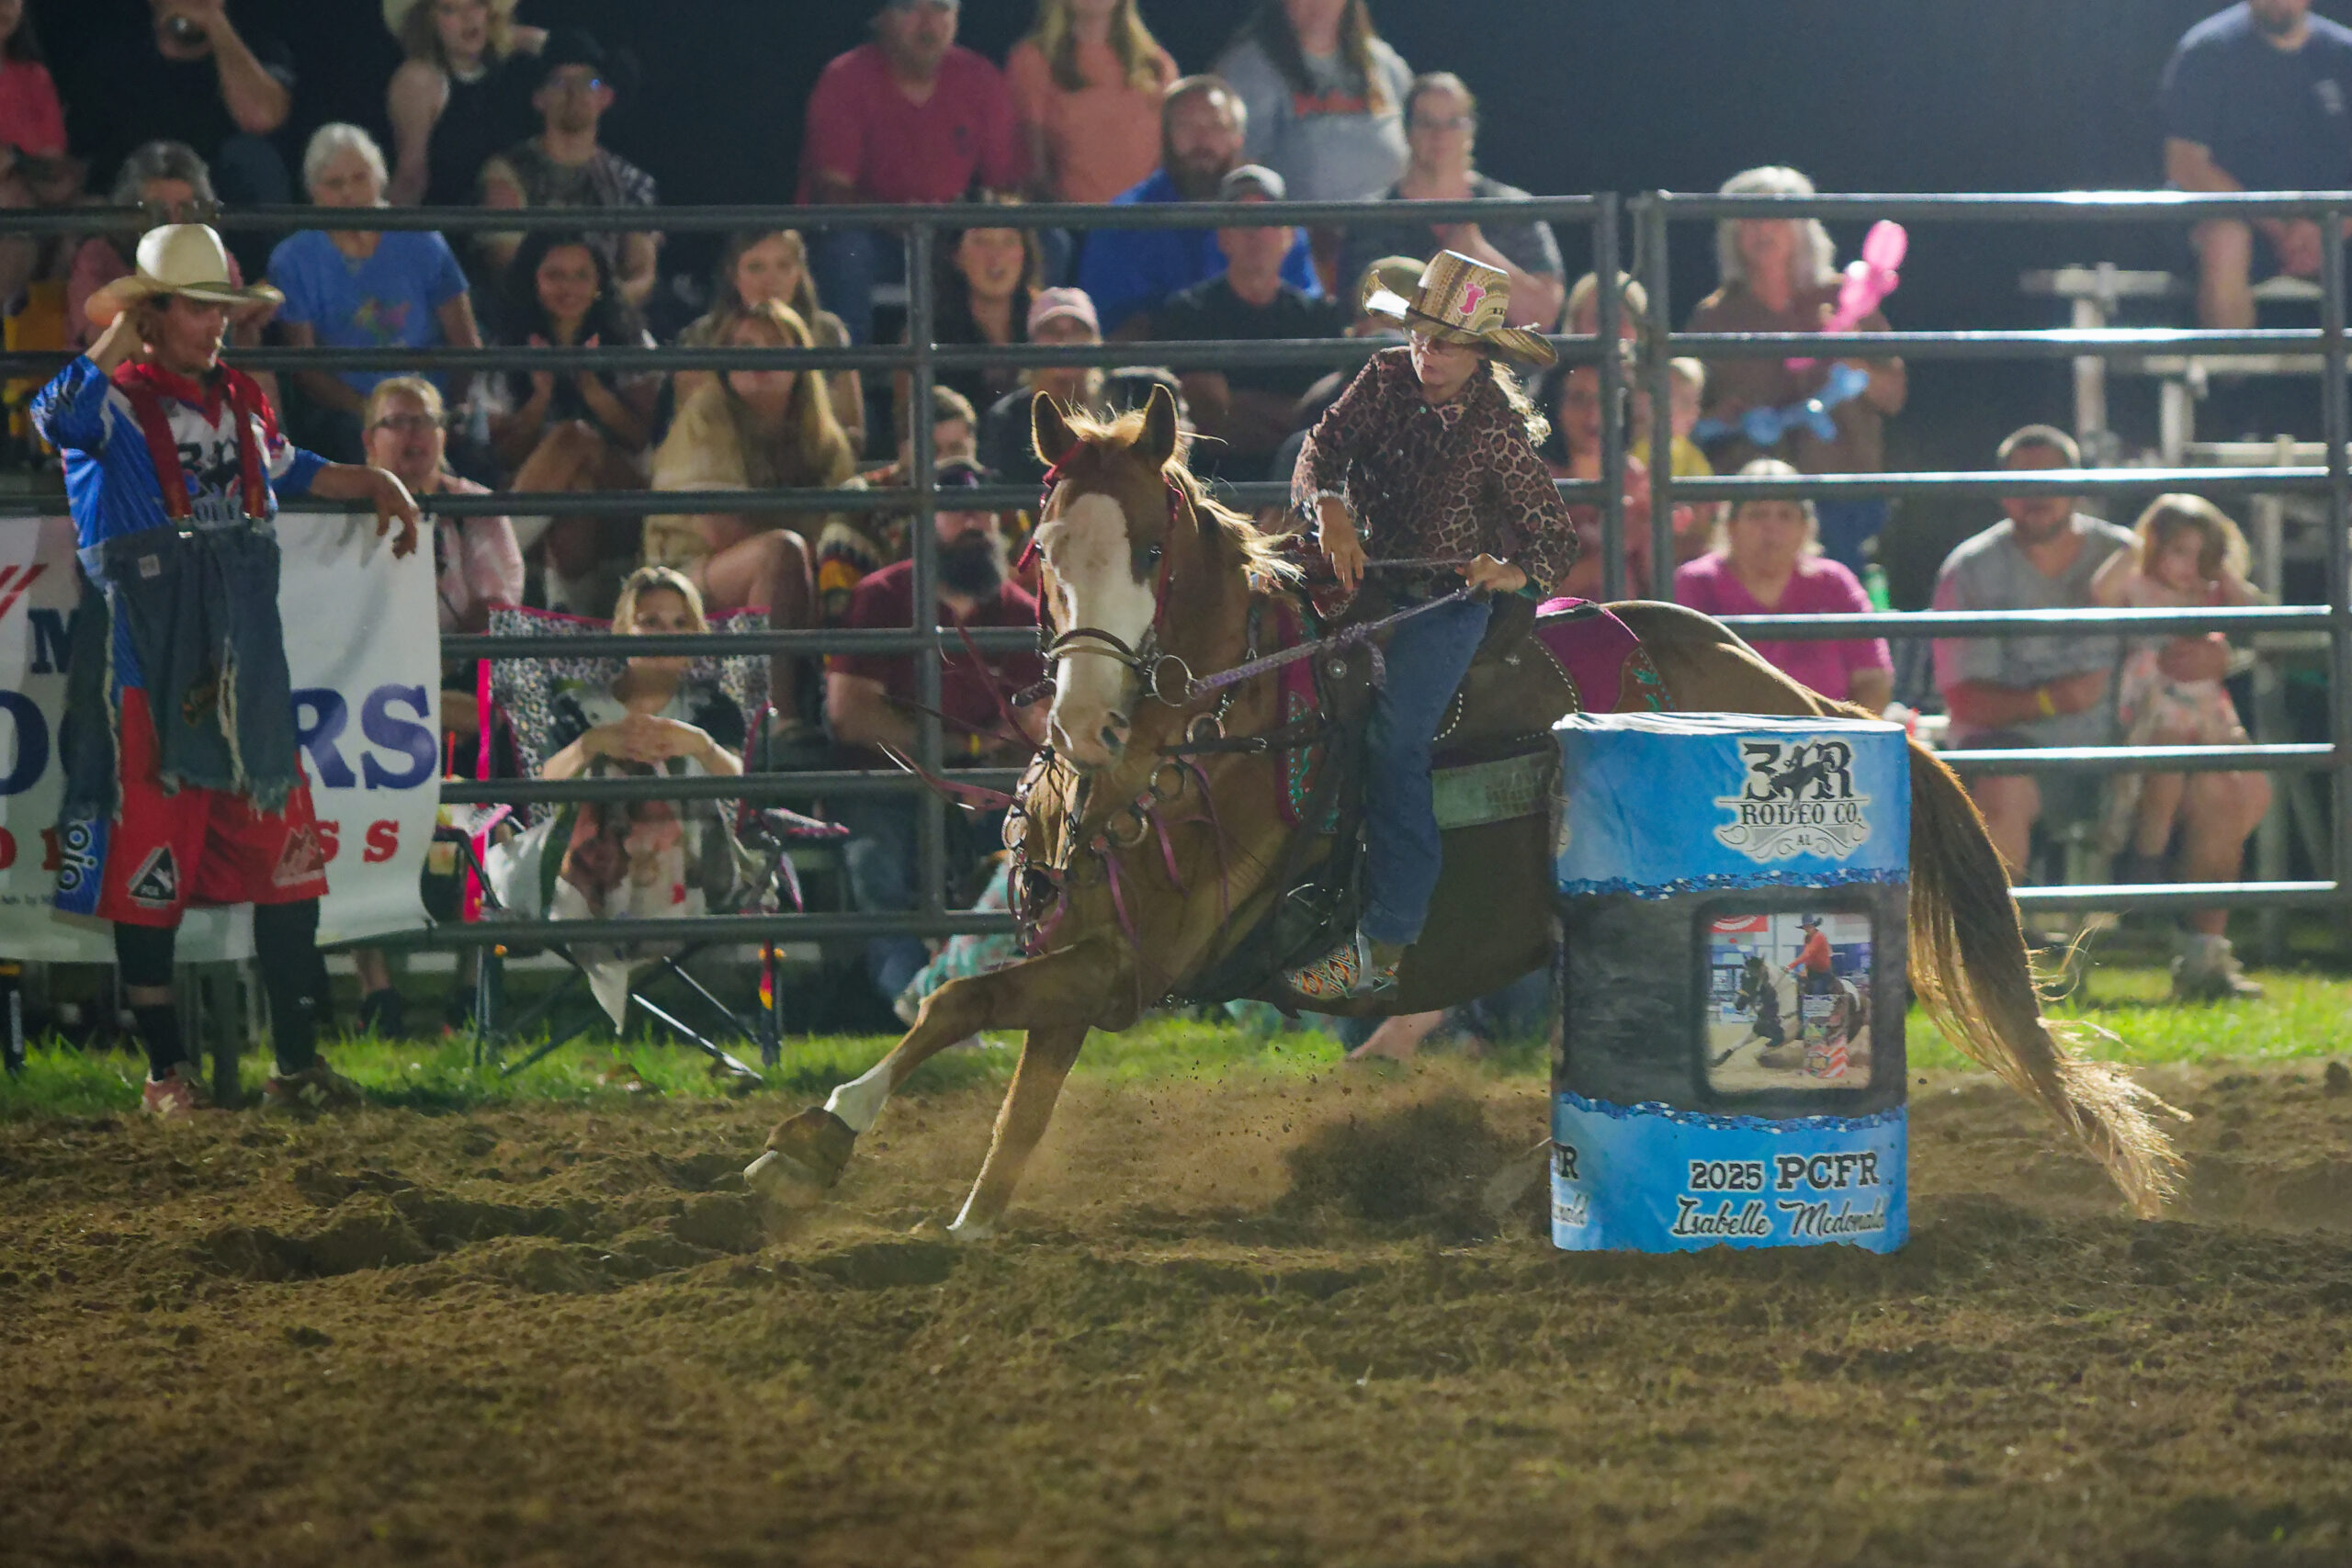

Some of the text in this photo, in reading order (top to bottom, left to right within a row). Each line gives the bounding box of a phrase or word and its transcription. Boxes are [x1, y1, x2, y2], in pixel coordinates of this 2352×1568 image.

[1740, 802, 1826, 826] RODEO
[1690, 1151, 1880, 1191] 2025 PCFR
[1671, 1197, 1768, 1235] Isabelle
